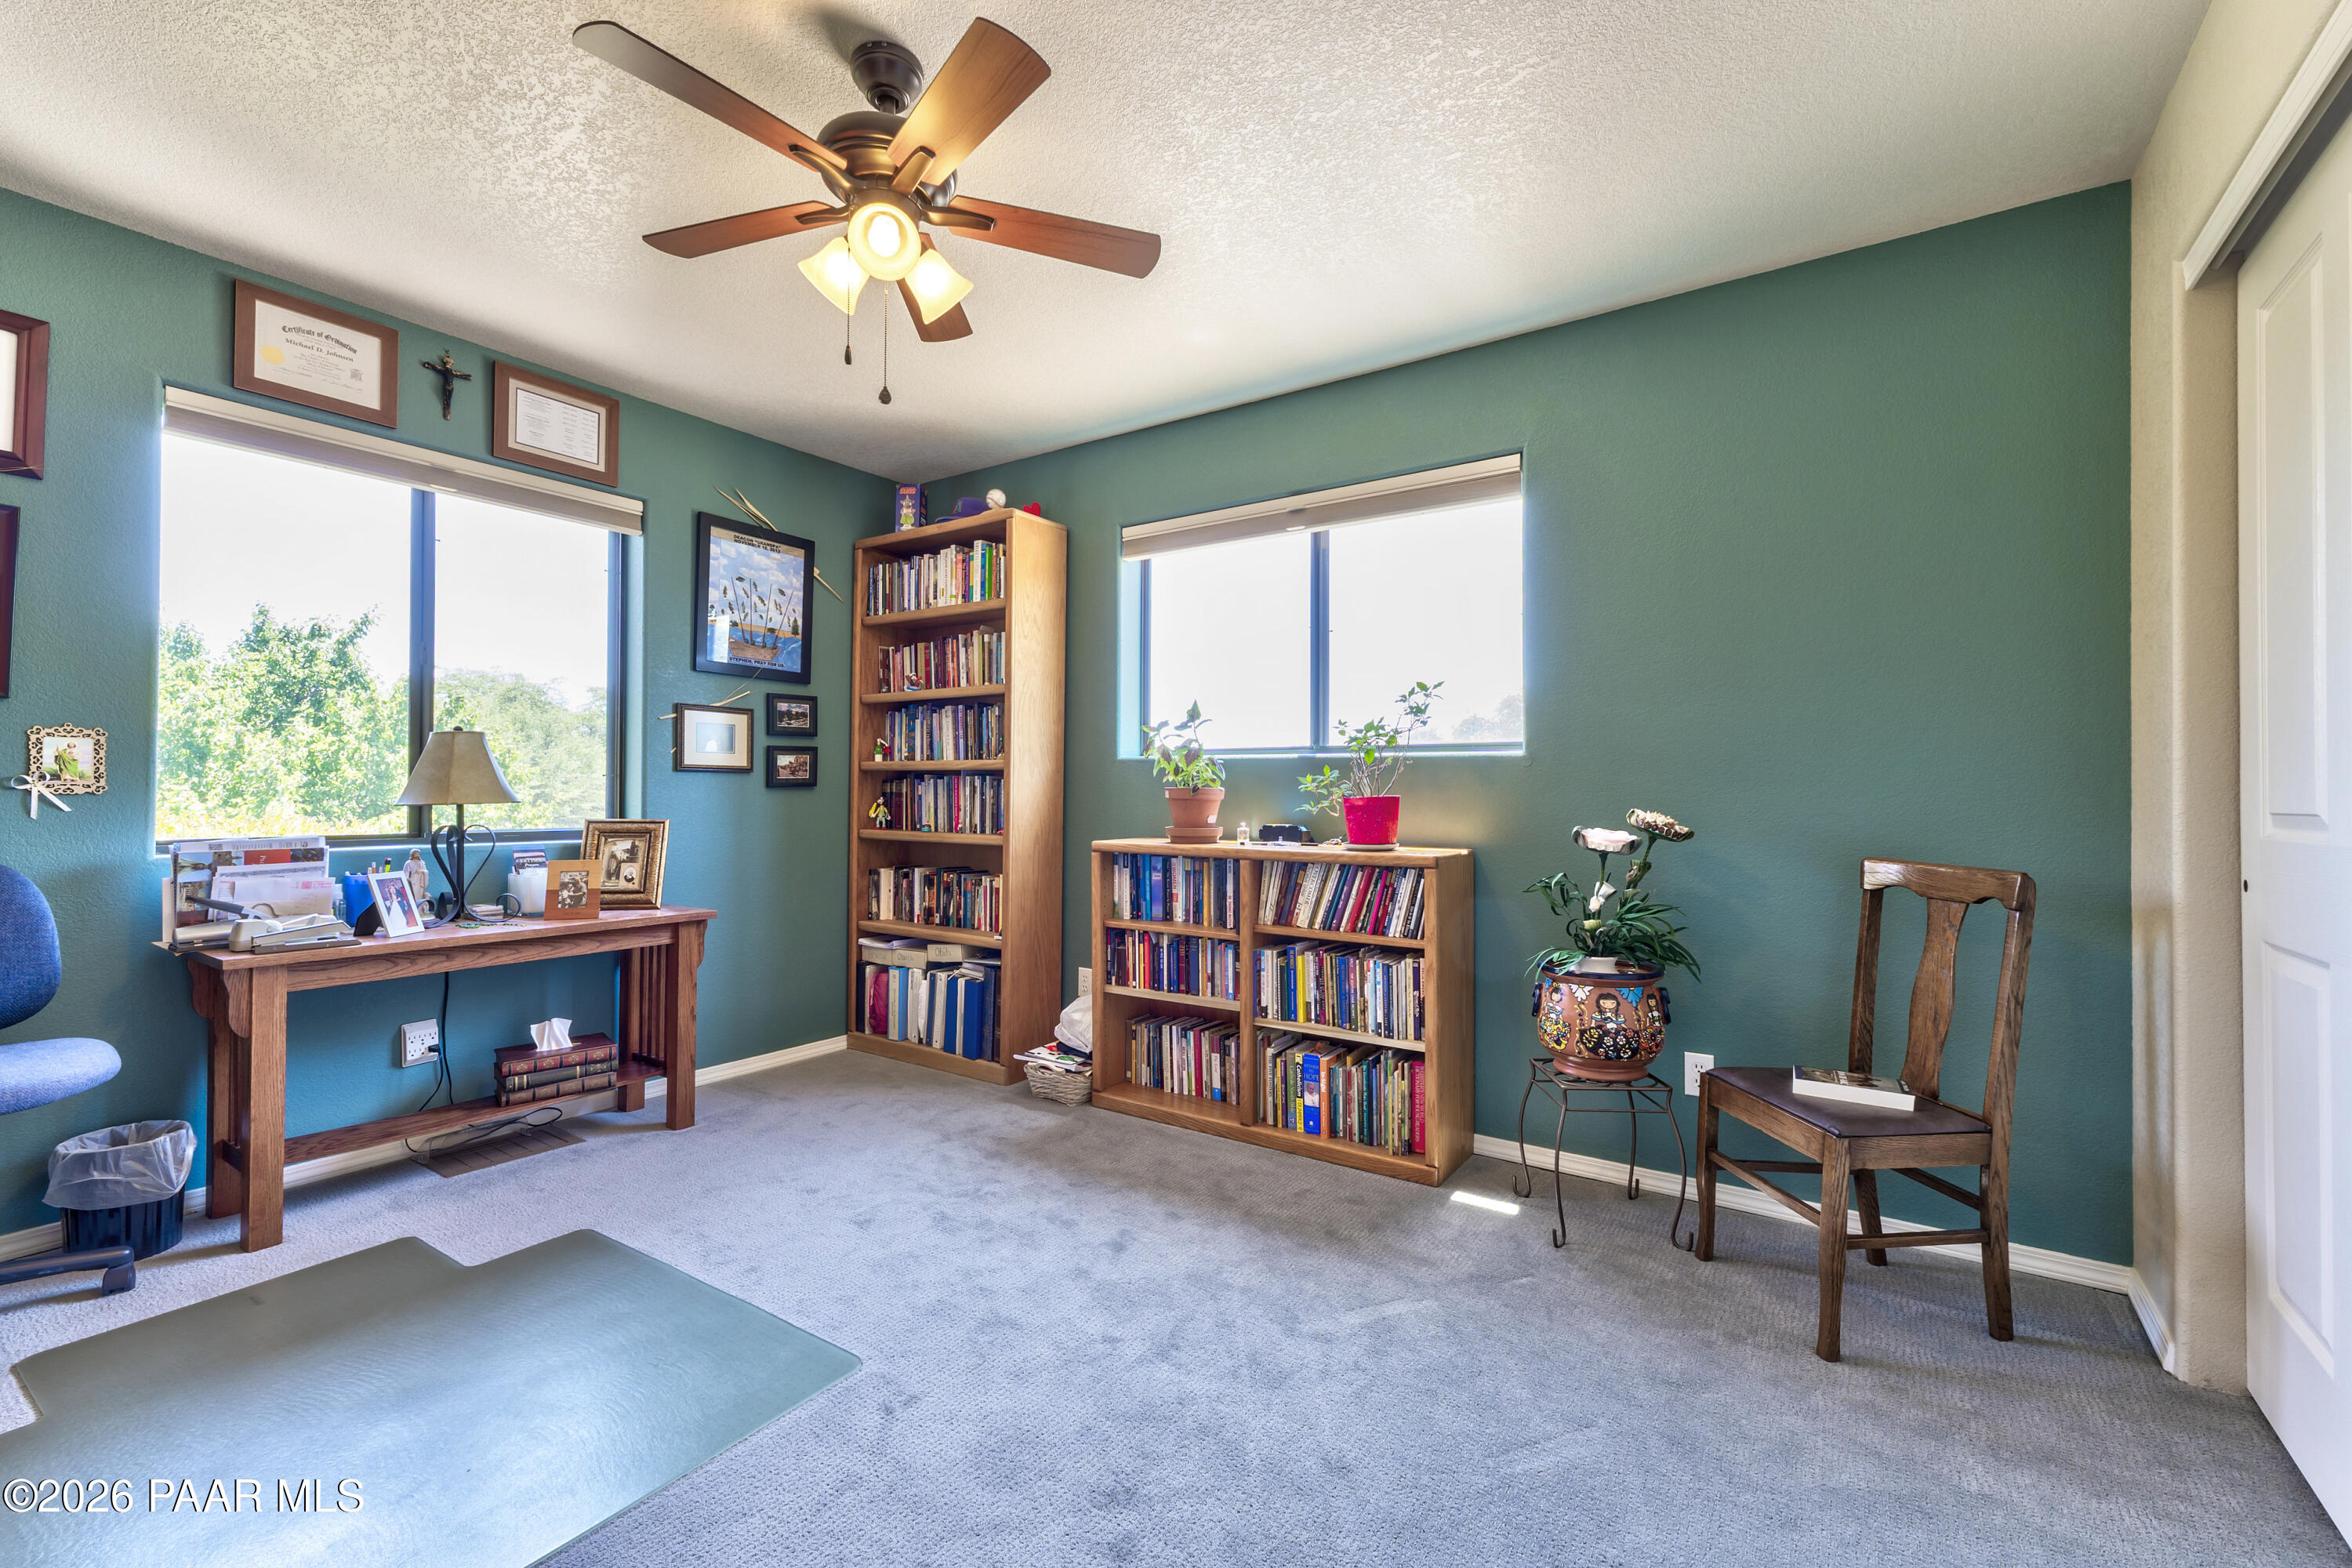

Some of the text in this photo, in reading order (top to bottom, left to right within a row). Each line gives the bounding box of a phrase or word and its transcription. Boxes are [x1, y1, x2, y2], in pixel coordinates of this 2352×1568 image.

[282, 325, 315, 336] Certificate
[325, 335, 358, 354] Ordination
[1305, 866, 1319, 905] OVERCOMER
